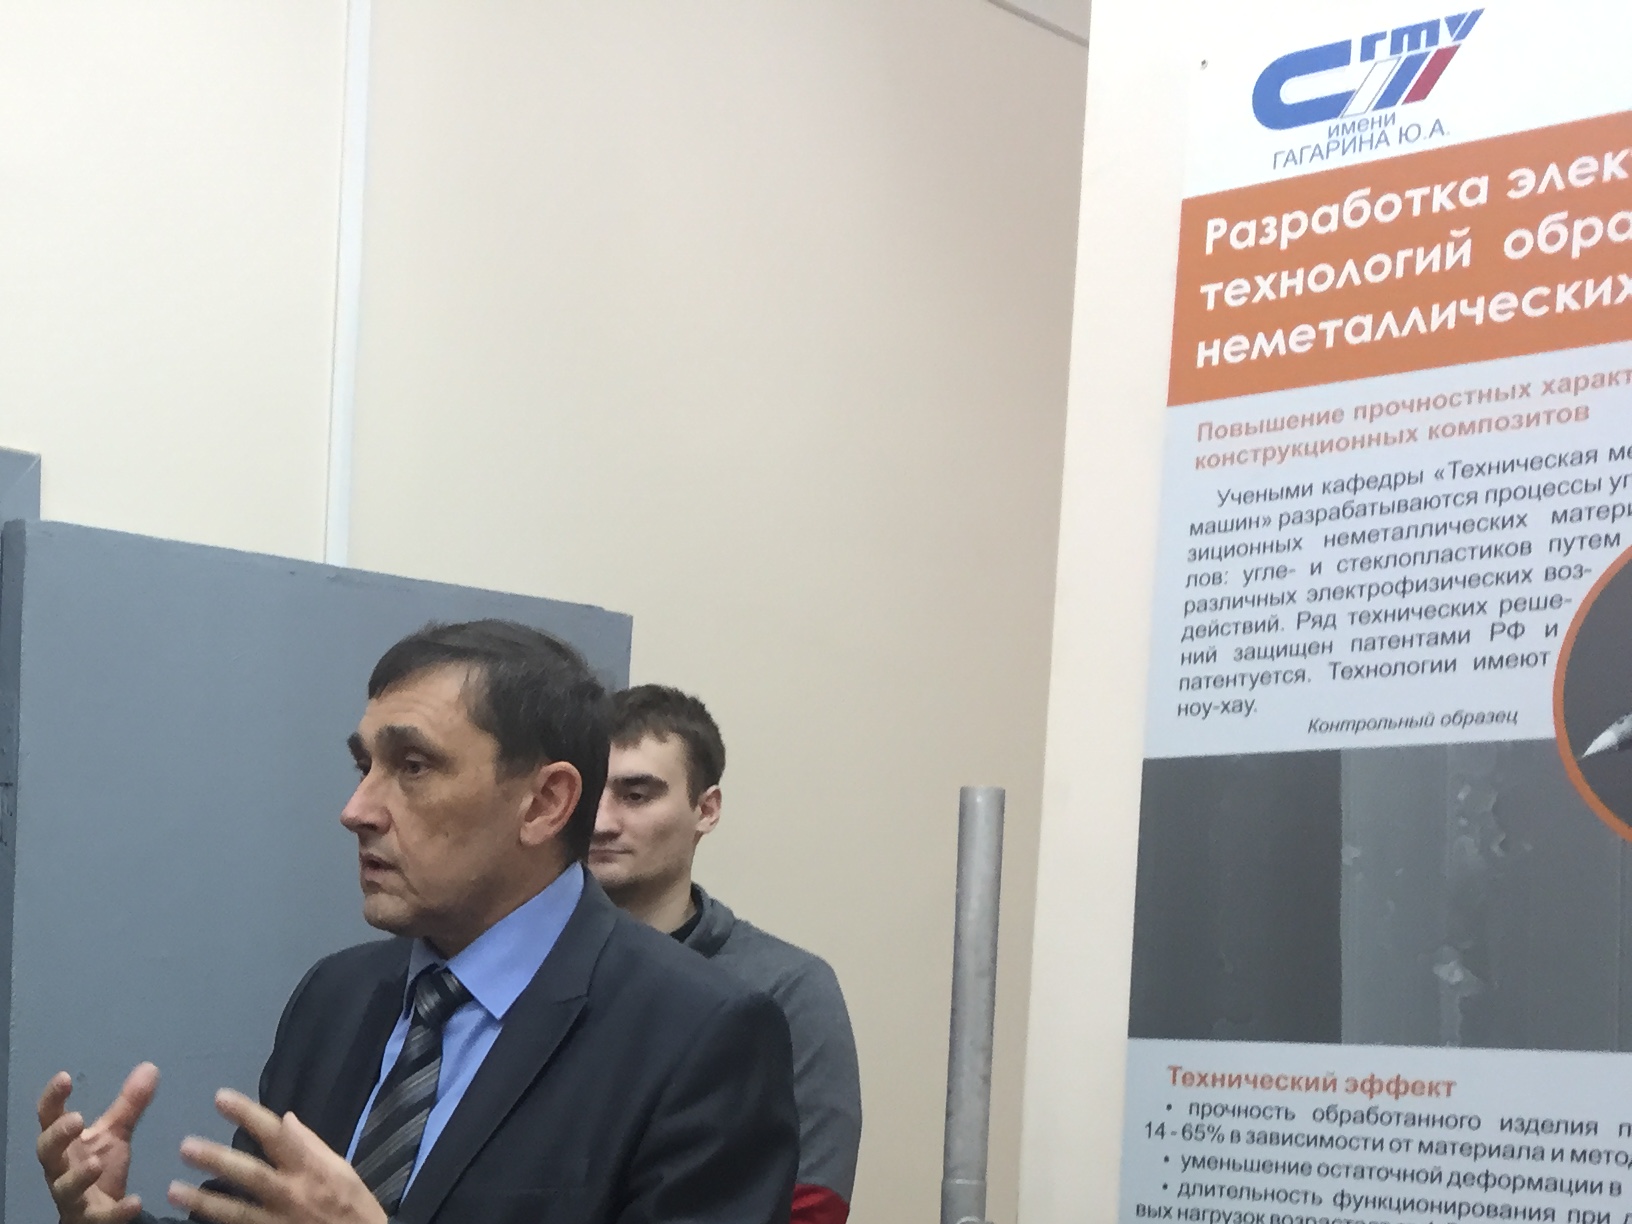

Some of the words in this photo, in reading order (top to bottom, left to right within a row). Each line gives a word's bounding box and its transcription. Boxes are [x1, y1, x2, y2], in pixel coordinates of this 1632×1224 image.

[1273, 129, 1390, 170] ГАГАРИНА
[1398, 118, 1450, 145] Ю.А.
[1327, 111, 1396, 139] имени
[1204, 175, 1489, 256] Разработка
[1506, 148, 1632, 200] элек
[1200, 226, 1472, 311] технологий
[1196, 273, 1632, 368] неметаллических
[1197, 408, 1344, 443] Повышение
[1354, 382, 1531, 424] прочностных
[1195, 428, 1418, 470] конструкционных
[1428, 405, 1590, 440] композитов
[1218, 483, 1313, 507] Учеными
[1322, 470, 1423, 496] кафедры
[1434, 449, 1598, 481] «Техническая
[1190, 515, 1272, 536] машин»
[1279, 491, 1478, 531] разрабатываются
[1485, 477, 1602, 507] процессы
[1185, 571, 1228, 588] лов:
[1243, 565, 1295, 588] угле-
[1310, 561, 1322, 576] и
[1337, 541, 1532, 573] стеклопластиков
[1549, 532, 1620, 557] путем
[1188, 537, 1302, 562] зиционных
[1324, 513, 1528, 548] неметаллических
[1184, 590, 1297, 618] различных
[1307, 568, 1533, 603] электрофизических
[1544, 564, 1592, 582] воз-
[1181, 614, 1284, 643] действий.
[1297, 611, 1337, 631] Ряд
[1348, 601, 1488, 625] технических
[1499, 594, 1572, 618] реше-
[1181, 646, 1217, 666] ний
[1234, 640, 1333, 662] защищен
[1351, 629, 1470, 652] патентами
[1490, 621, 1525, 642] РФ
[1545, 623, 1558, 638] и
[1179, 668, 1311, 691] патентуется.
[1329, 658, 1456, 680] Технологии
[1474, 651, 1550, 670] имеют
[1178, 699, 1257, 720] ноу-хау.
[1308, 712, 1435, 735] Контрольный
[1440, 710, 1518, 729] образец
[1167, 1065, 1337, 1093] Технический
[1345, 1072, 1457, 1101] эффект
[1189, 1102, 1296, 1121] прочность
[1312, 1104, 1481, 1131] обработанного
[1500, 1117, 1598, 1136] изделия
[1230, 1129, 1241, 1144] в
[1246, 1130, 1384, 1152] зависимости
[1389, 1138, 1413, 1153] от
[1418, 1140, 1545, 1162] материала
[1551, 1148, 1564, 1162] и
[1570, 1148, 1632, 1170] мето
[1181, 1154, 1312, 1177] уменьшение
[1317, 1162, 1442, 1184] остаточной
[1446, 1169, 1603, 1197] деформации
[1609, 1181, 1622, 1197] в
[1136, 1203, 1173, 1219] вых
[1177, 1182, 1323, 1206] длительность
[1333, 1189, 1555, 1222] функционирования
